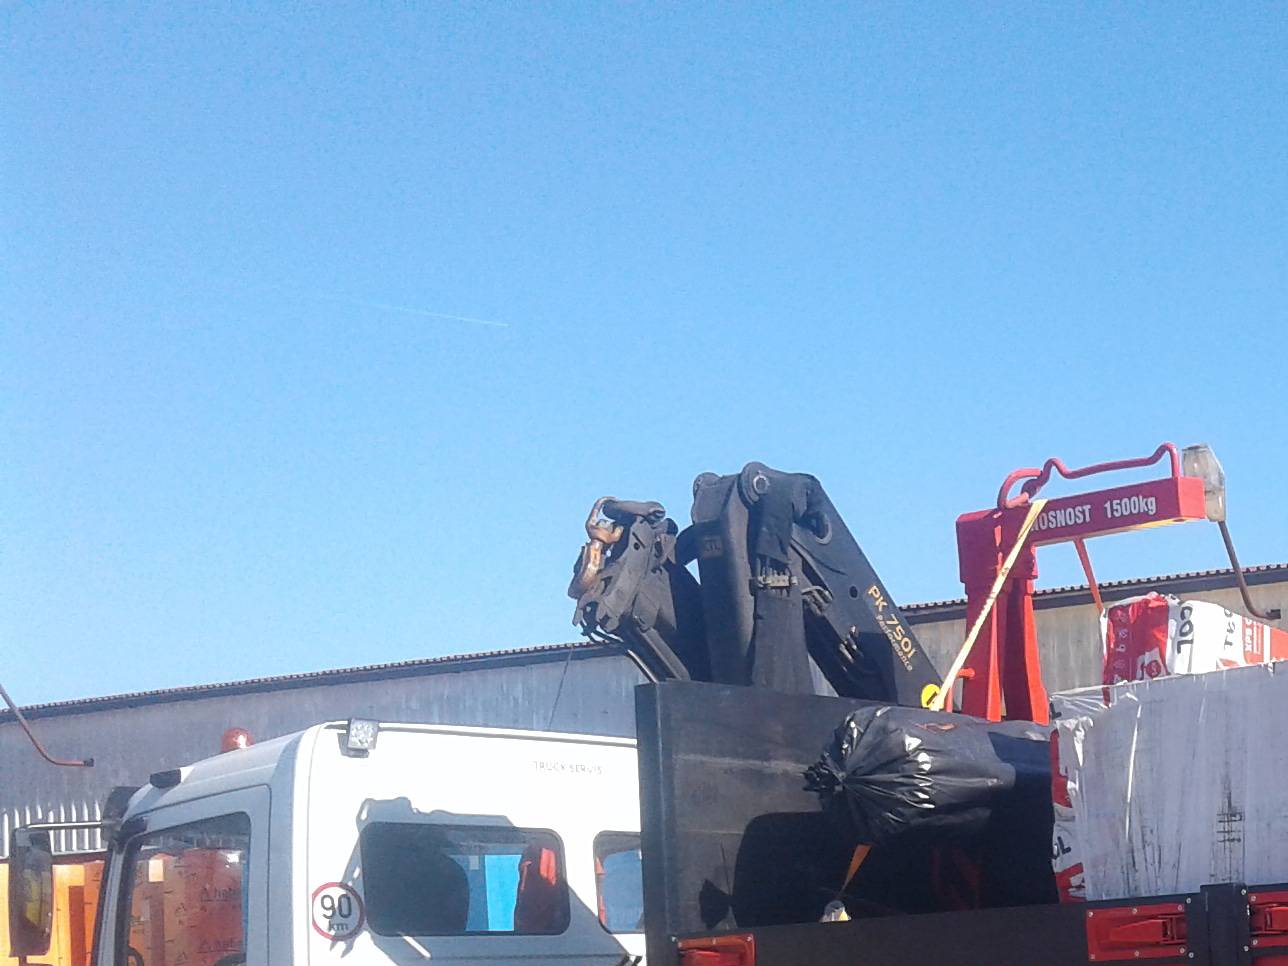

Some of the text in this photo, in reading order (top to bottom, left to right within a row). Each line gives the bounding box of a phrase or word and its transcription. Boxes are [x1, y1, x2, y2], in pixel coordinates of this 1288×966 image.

[1104, 495, 1157, 518] 1500kg
[320, 894, 352, 920] 90
[328, 919, 349, 932] km
